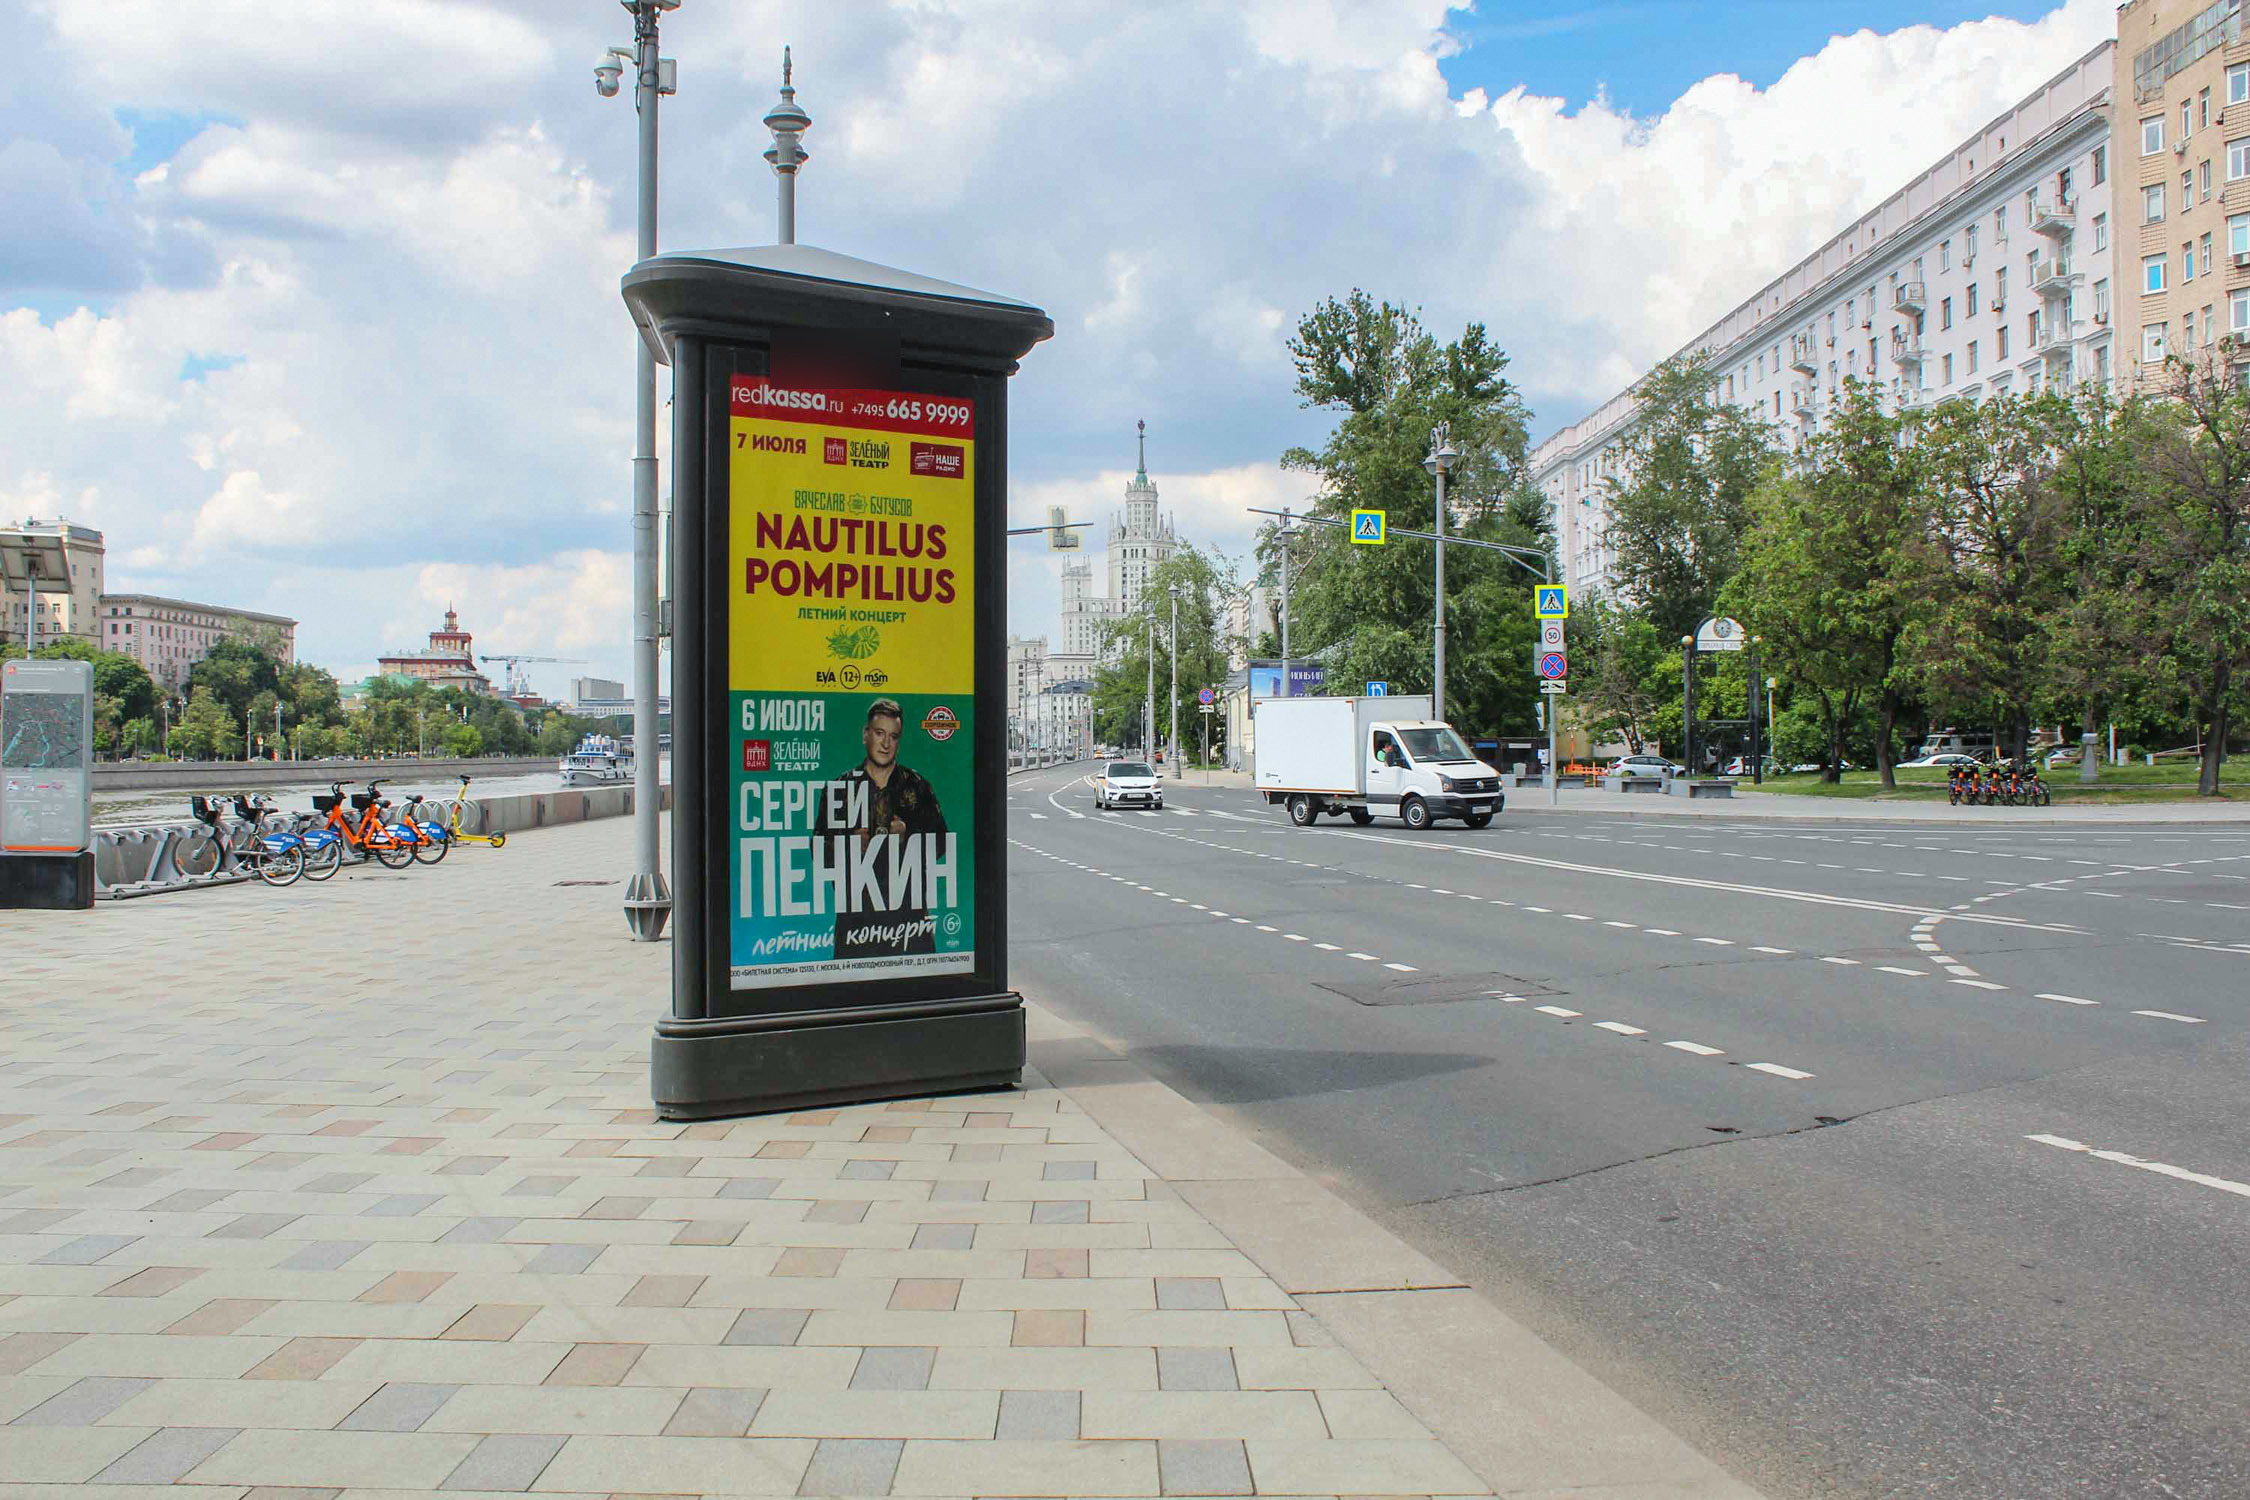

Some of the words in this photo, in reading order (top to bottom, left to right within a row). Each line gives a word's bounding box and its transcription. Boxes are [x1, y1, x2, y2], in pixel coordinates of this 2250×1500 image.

[732, 384, 844, 413] redkassa.ru
[852, 403, 884, 417] +7495
[887, 399, 921, 420] 665
[926, 402, 970, 426] 9999
[737, 432, 748, 449] 7
[752, 434, 807, 454] ИЮЛЯ
[851, 458, 889, 469] ТЕАТР
[936, 454, 960, 466] НАШЕ
[794, 489, 845, 512] ВЯЧЕСЛАВ
[870, 495, 913, 517] БУТУСОВ
[757, 511, 947, 560] NAUTILUS
[746, 557, 956, 604] POMPILIUS
[797, 605, 847, 621] ЛЕТНИЙ
[850, 609, 907, 624] КОНЦЕРТ
[816, 667, 836, 684] EVA
[844, 672, 859, 682] 12+
[742, 699, 755, 731] 6
[760, 699, 825, 732] ИЮЛЯ
[774, 762, 820, 771] ТЕАТР
[740, 771, 869, 831] СЕРГЕЙ
[740, 832, 958, 918] ПЕНКИН
[752, 923, 835, 956] летний
[845, 914, 939, 951] концерт
[947, 916, 960, 931] 6+
